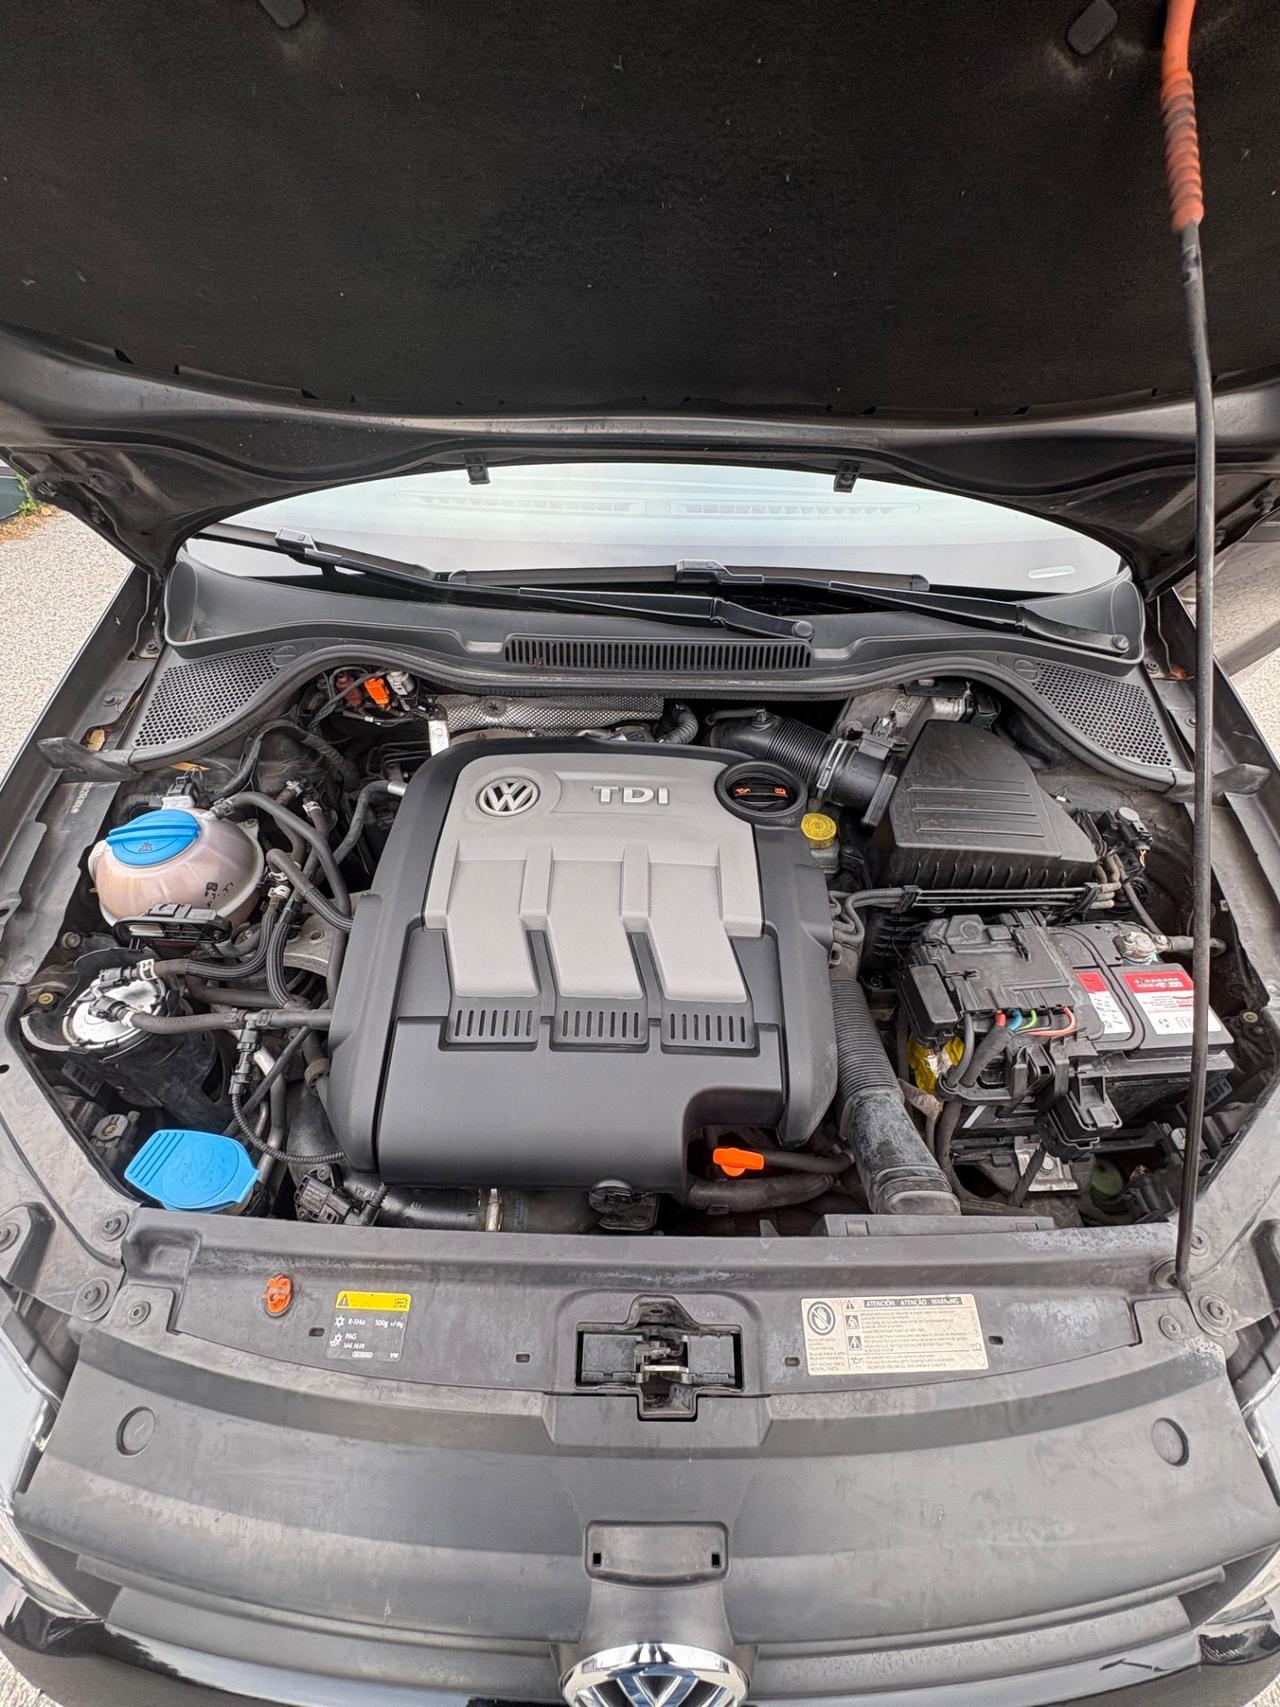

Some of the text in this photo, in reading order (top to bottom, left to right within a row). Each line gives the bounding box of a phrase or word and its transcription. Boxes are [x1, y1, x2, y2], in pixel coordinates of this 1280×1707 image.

[478, 777, 540, 816] VW
[593, 786, 669, 805] TDI
[866, 1299, 896, 1307] ATENCIÓN
[930, 1296, 960, 1305] WARNING
